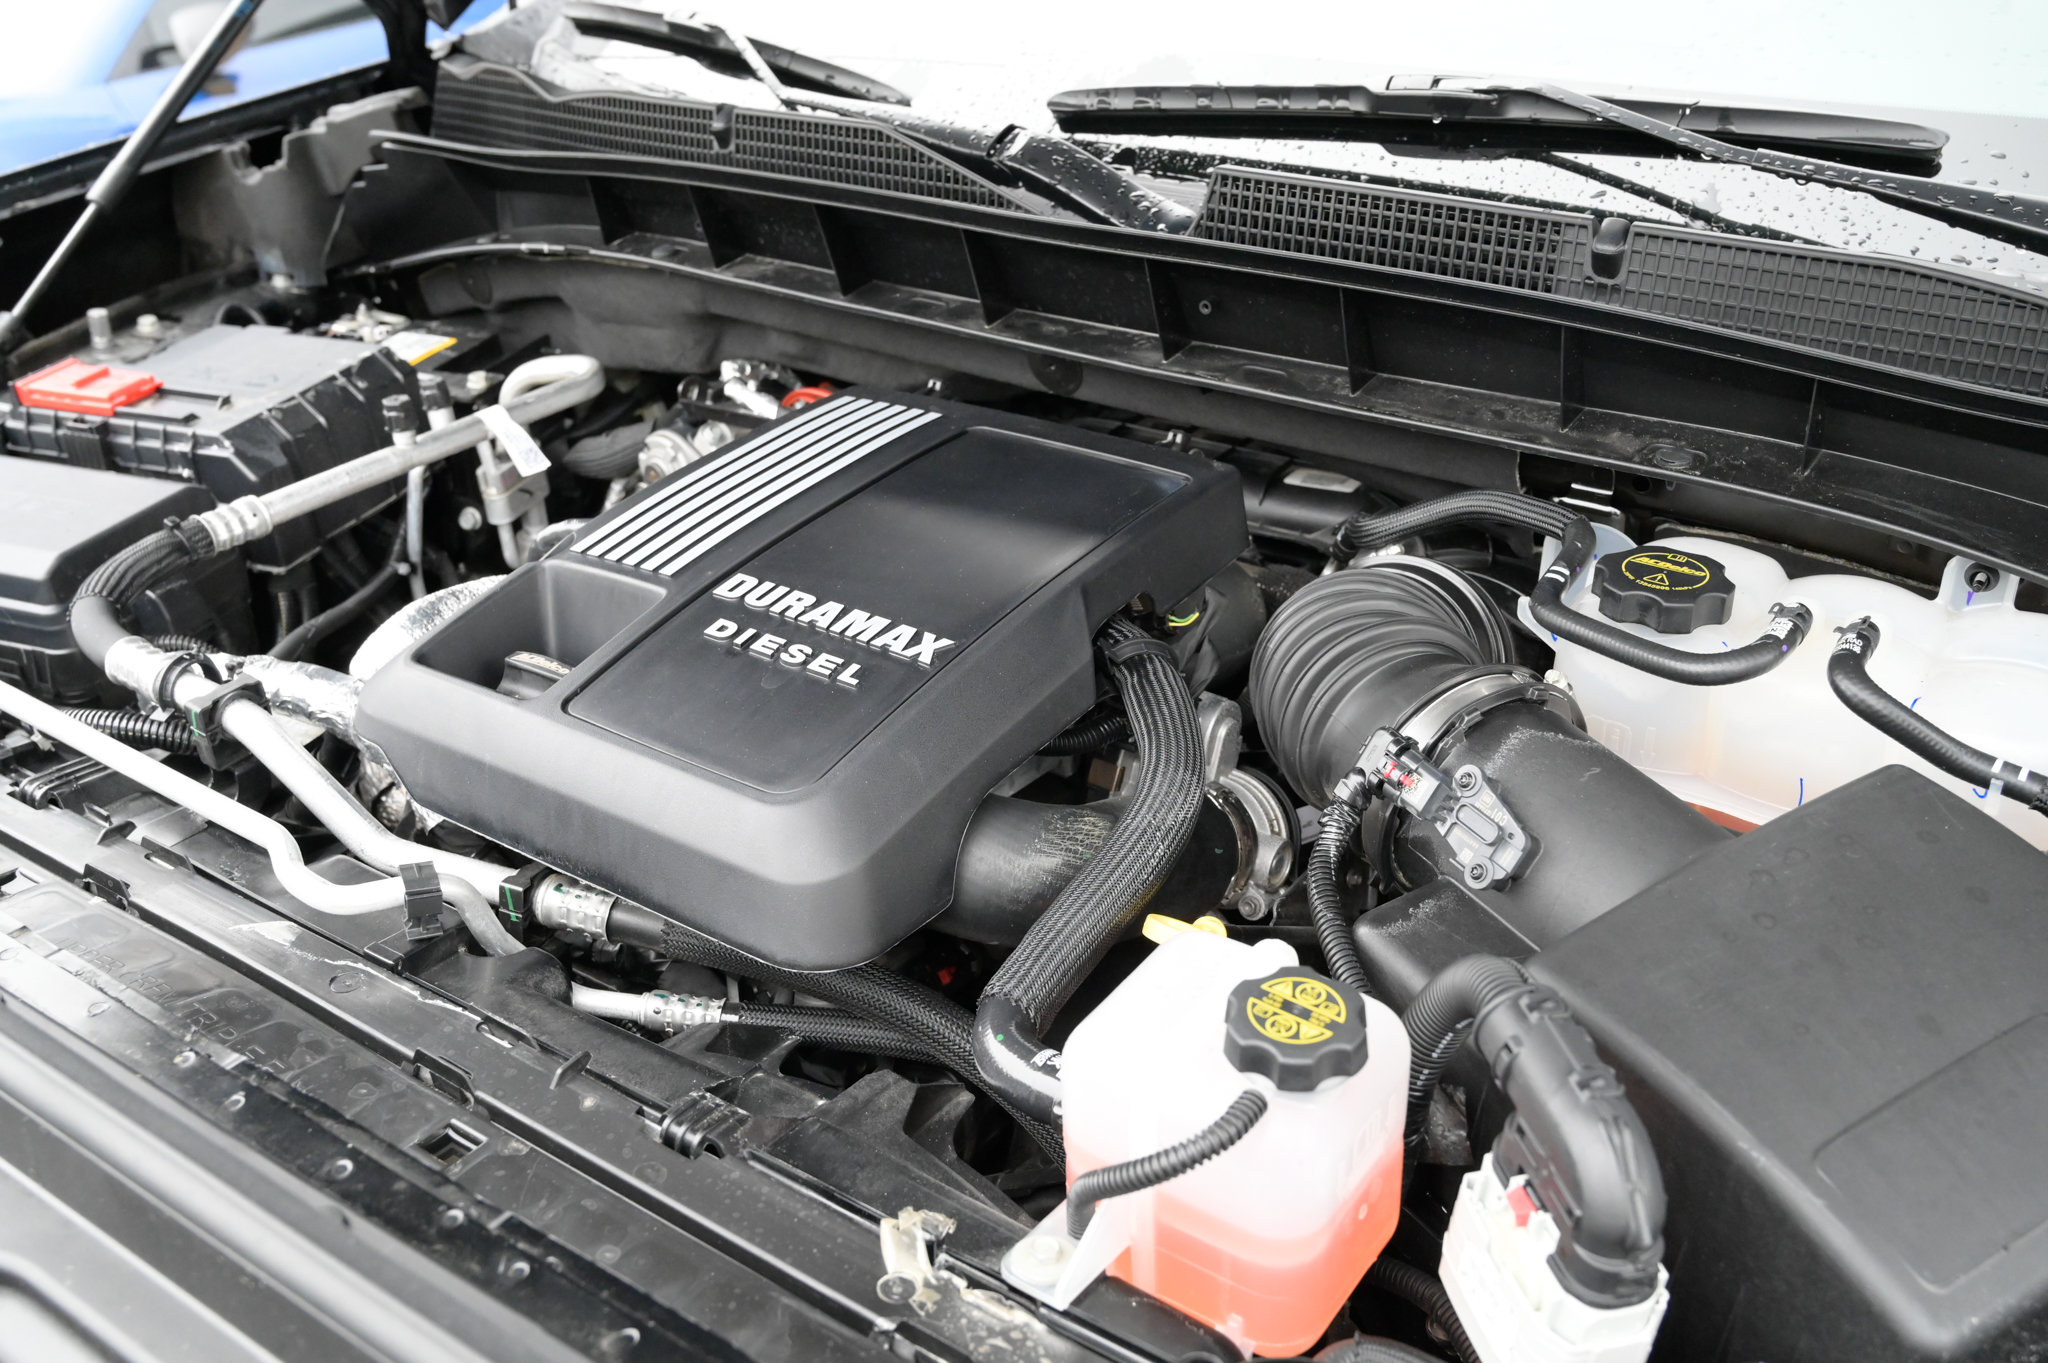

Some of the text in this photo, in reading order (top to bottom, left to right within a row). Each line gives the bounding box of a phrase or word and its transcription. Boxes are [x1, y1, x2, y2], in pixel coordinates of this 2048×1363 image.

[1630, 557, 1707, 577] ACDelco
[713, 573, 956, 668] DURAMAX
[509, 653, 571, 675] ACDelco
[704, 618, 862, 689] DIESEL
